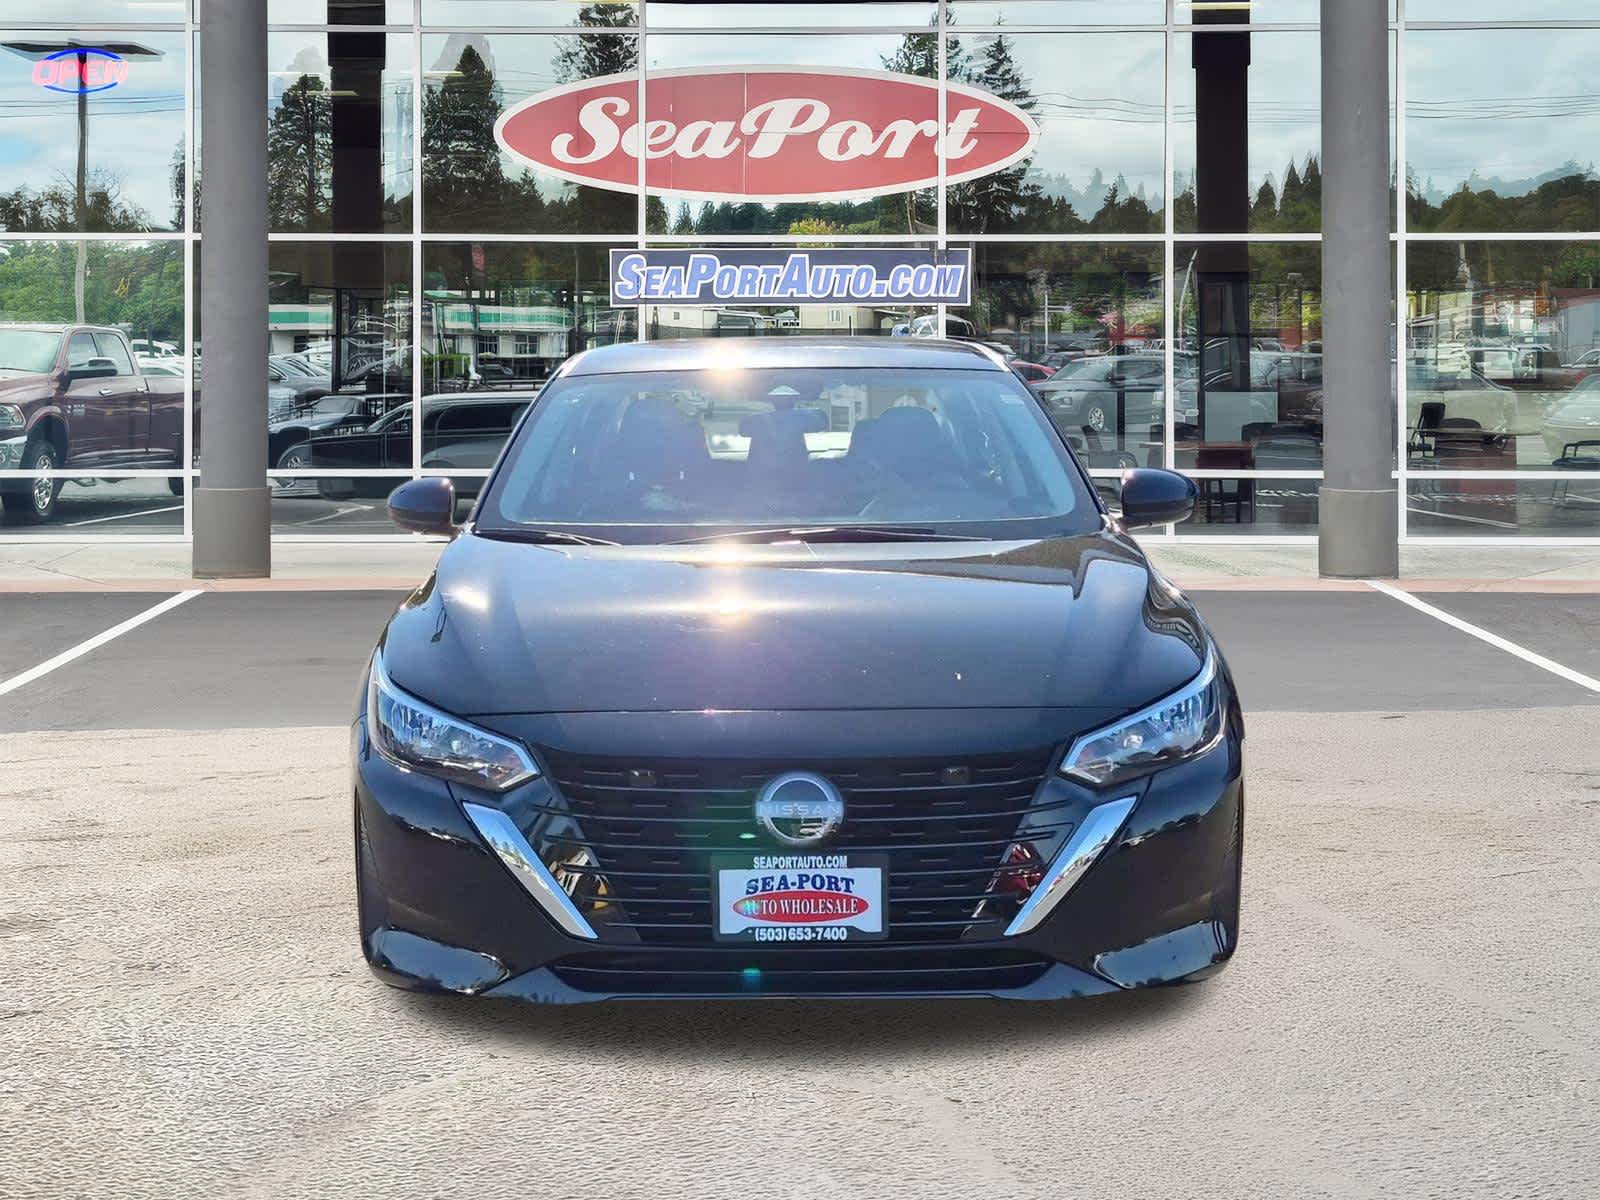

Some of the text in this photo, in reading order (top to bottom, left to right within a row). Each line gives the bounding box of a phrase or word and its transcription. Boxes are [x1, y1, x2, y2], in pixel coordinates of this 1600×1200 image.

[32, 60, 128, 86] OPEN
[550, 96, 982, 164] SeaPort
[759, 804, 842, 817] NISSAN
[753, 855, 848, 869] SEAPORTAUTO.COM
[745, 874, 855, 895] SEA-PORT
[780, 898, 858, 914] WHOLESALE
